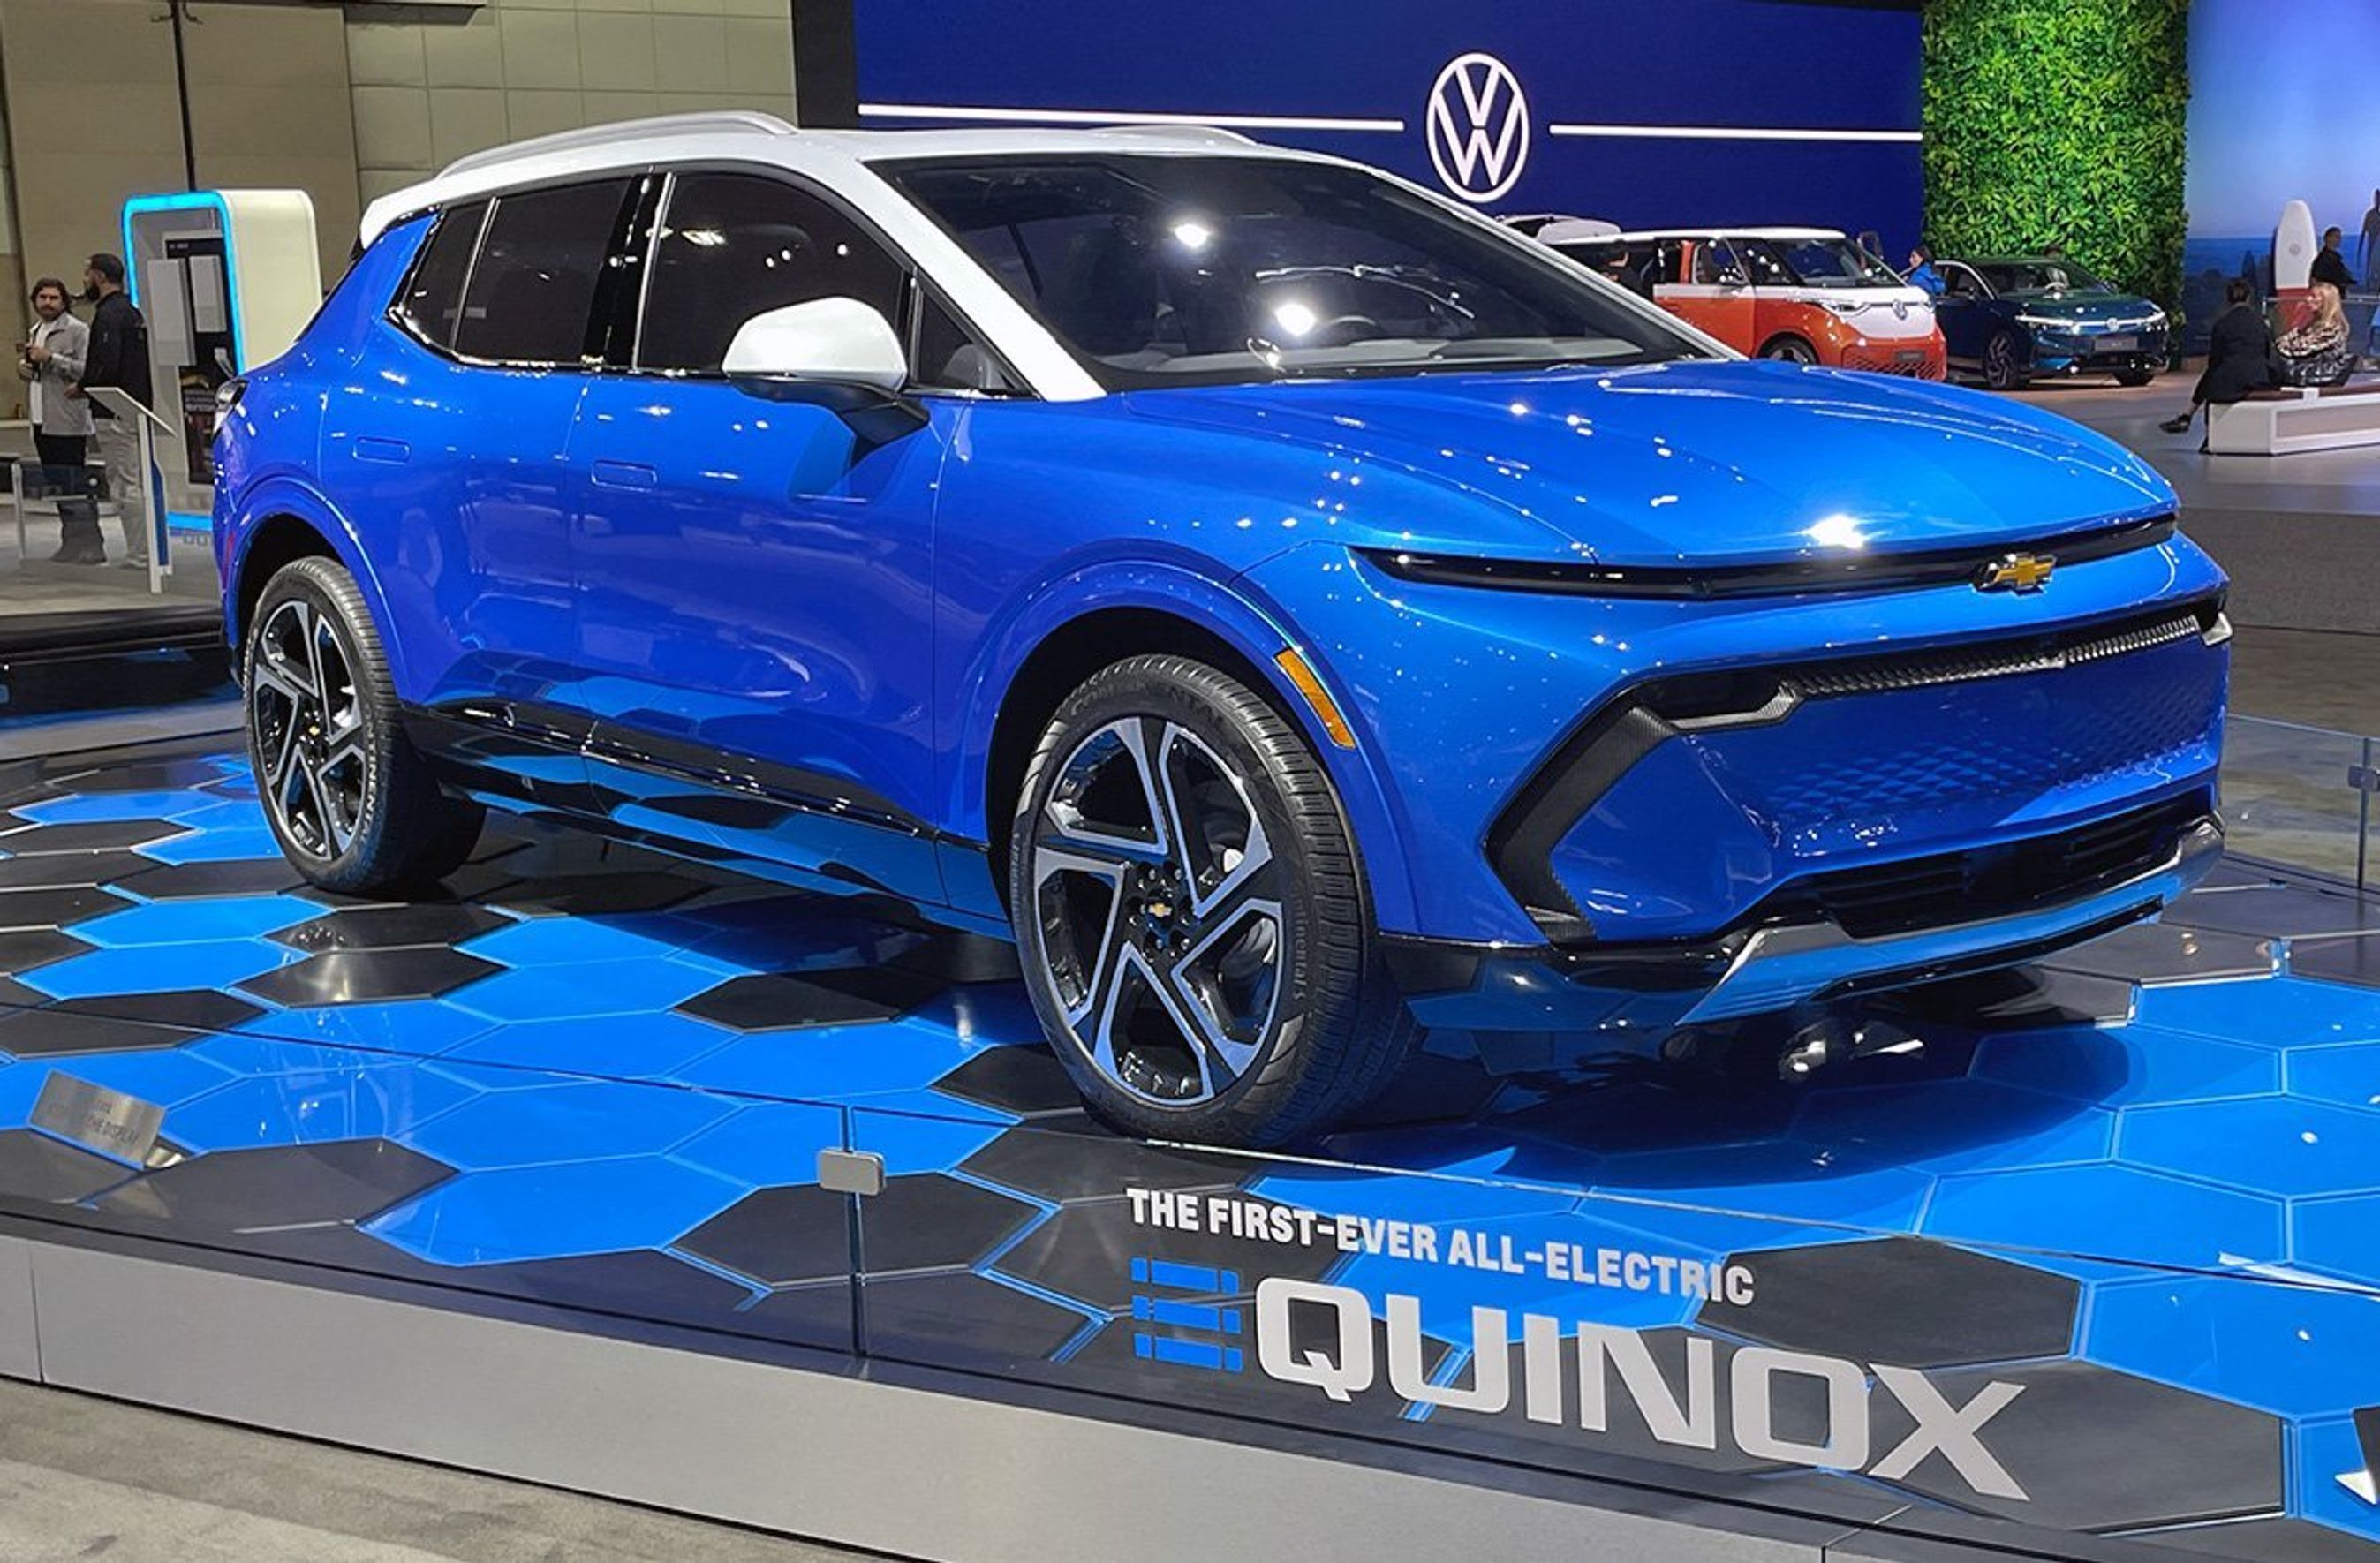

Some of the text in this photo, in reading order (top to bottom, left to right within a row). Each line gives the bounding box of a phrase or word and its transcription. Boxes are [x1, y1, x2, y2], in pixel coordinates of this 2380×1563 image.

[1429, 57, 1527, 196] VW
[1127, 1188, 1754, 1306] THE FIRST-EVER ALL-ELECTRIC
[1130, 1257, 2029, 1501] EQUINOX
